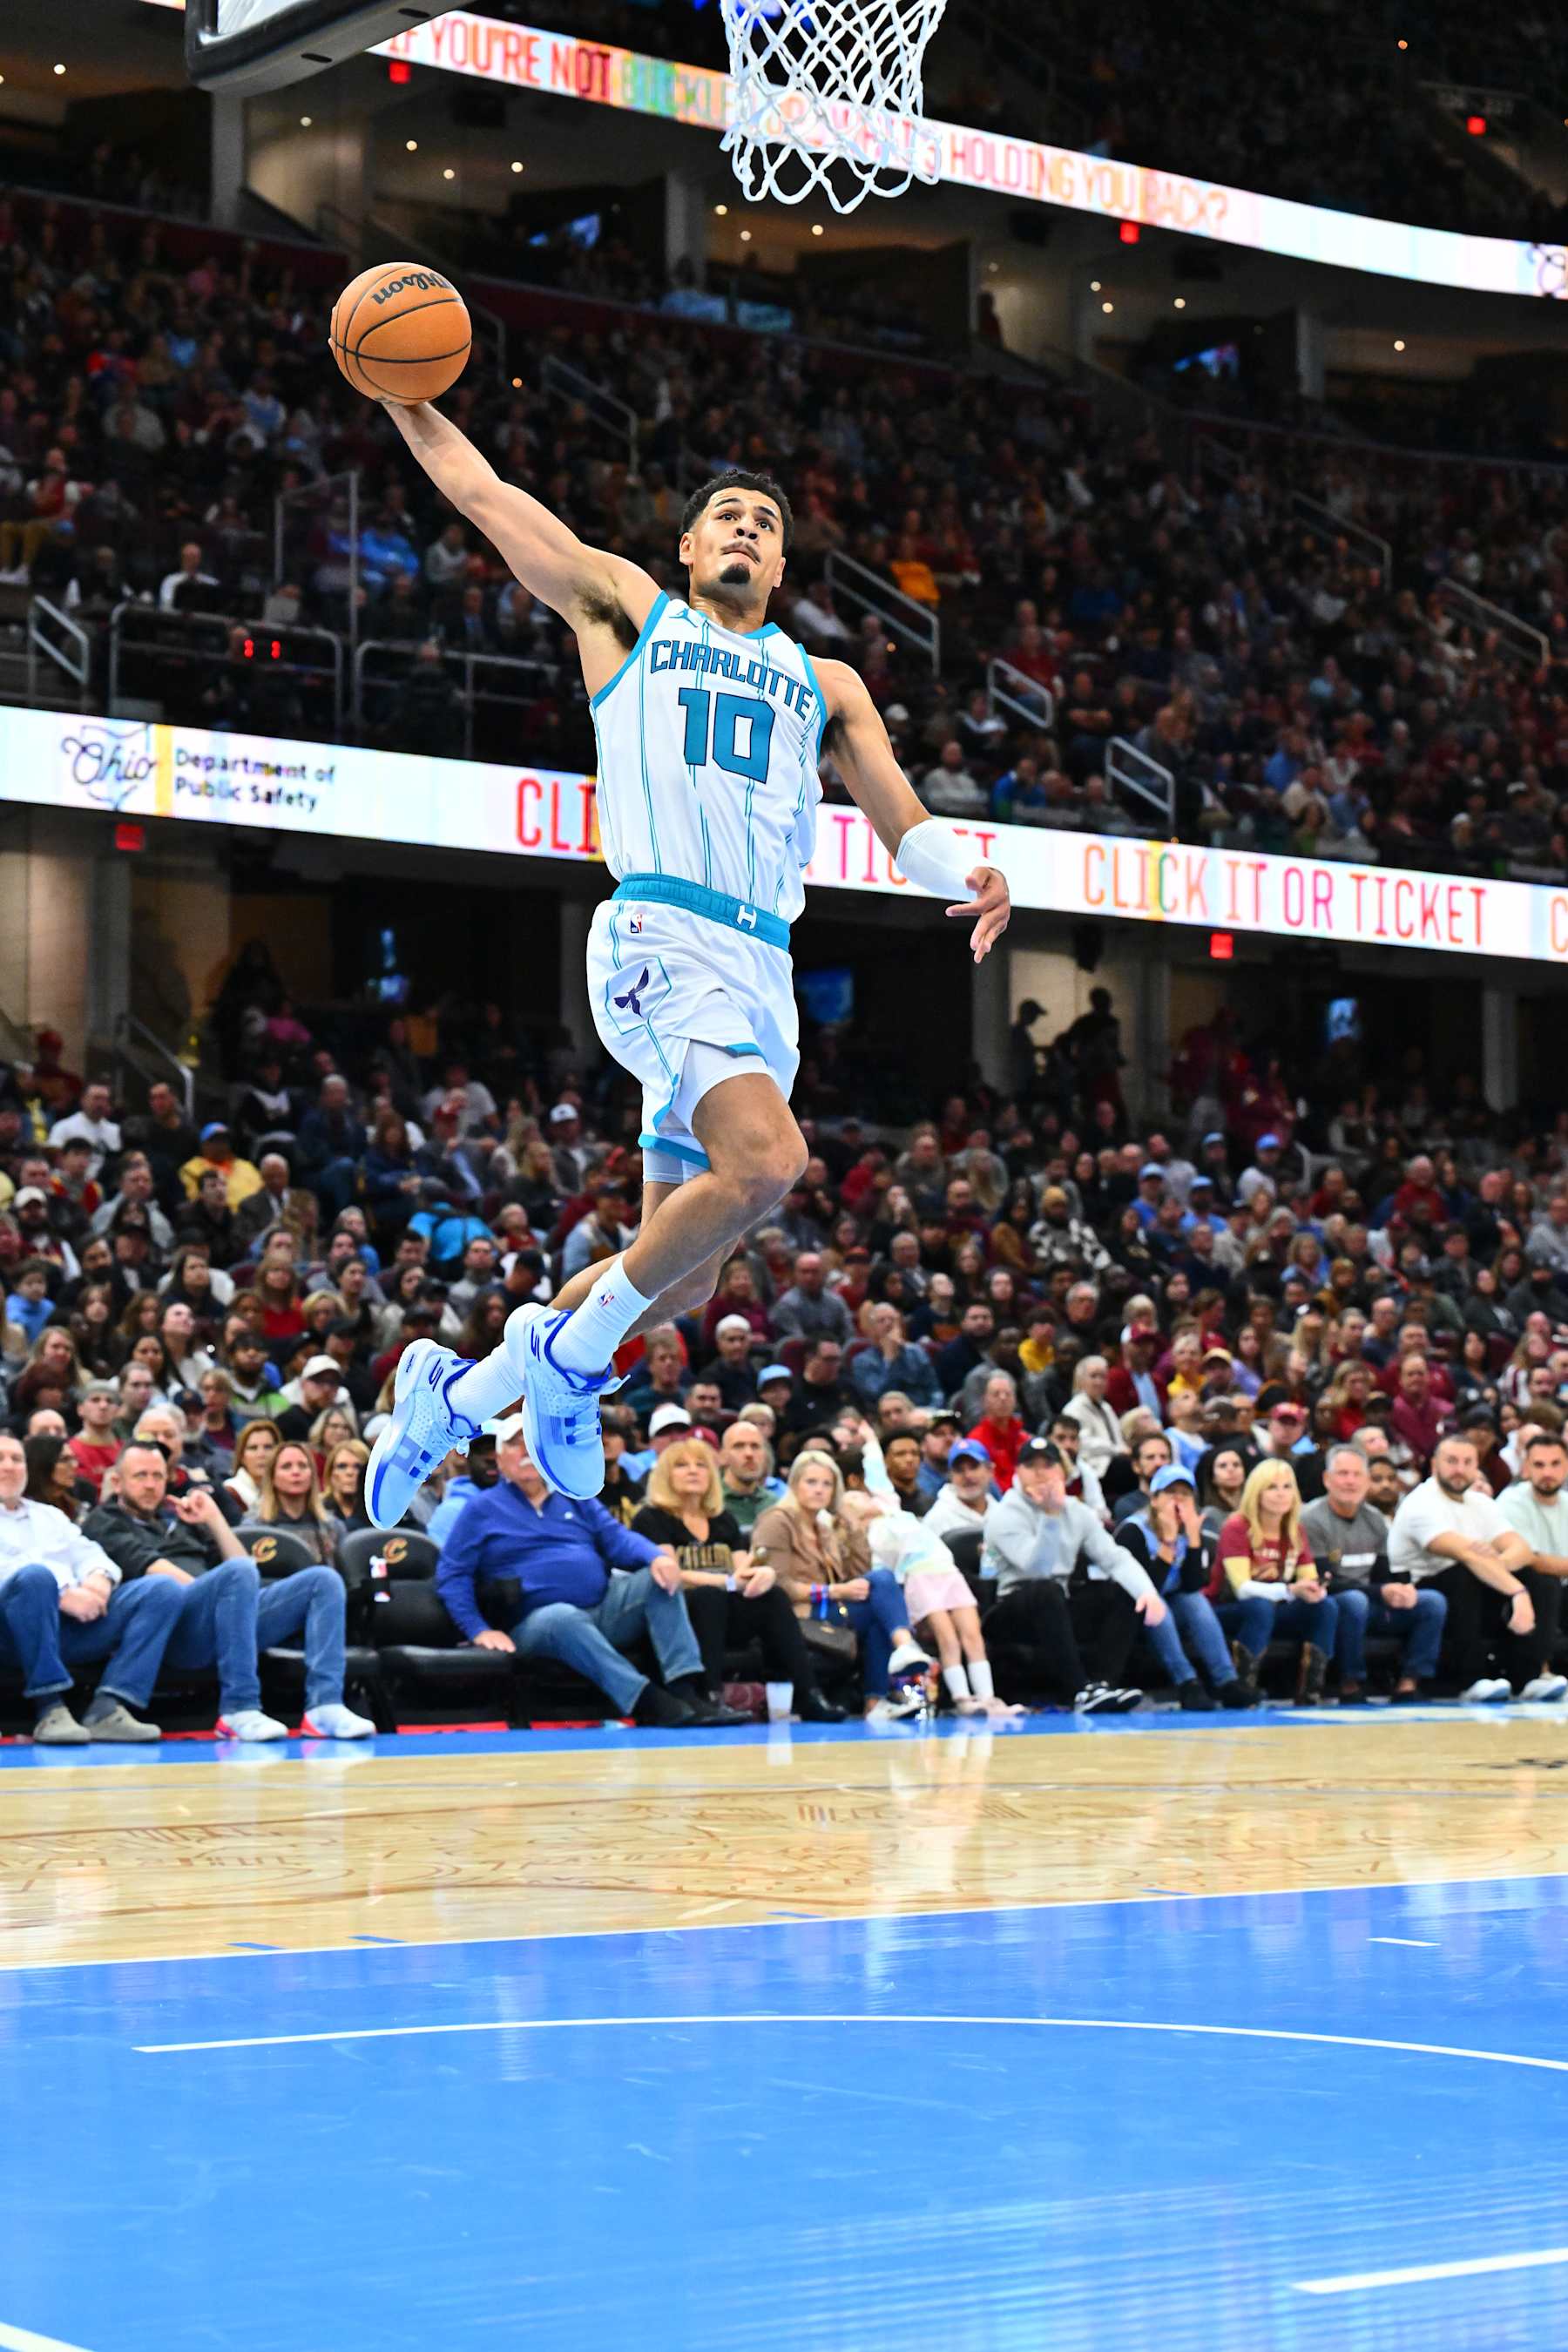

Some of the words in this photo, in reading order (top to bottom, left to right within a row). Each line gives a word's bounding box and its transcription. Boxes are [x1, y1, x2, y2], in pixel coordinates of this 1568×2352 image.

[430, 17, 541, 84] YOU'RE
[551, 42, 611, 98] NOT
[950, 133, 1074, 200] HOLDING
[1081, 160, 1135, 213] YOU
[650, 639, 814, 721] CHARLOTTE
[61, 736, 156, 785] Ohio
[176, 748, 307, 780] Department
[315, 765, 335, 782] of
[678, 686, 776, 785] 10
[176, 776, 241, 801] Public
[250, 785, 317, 813] Safety
[516, 777, 598, 853] CLI
[1084, 843, 1208, 917] CLICK
[1225, 859, 1268, 923] IT
[1283, 866, 1334, 930] OR
[1349, 873, 1486, 947] TICKET
